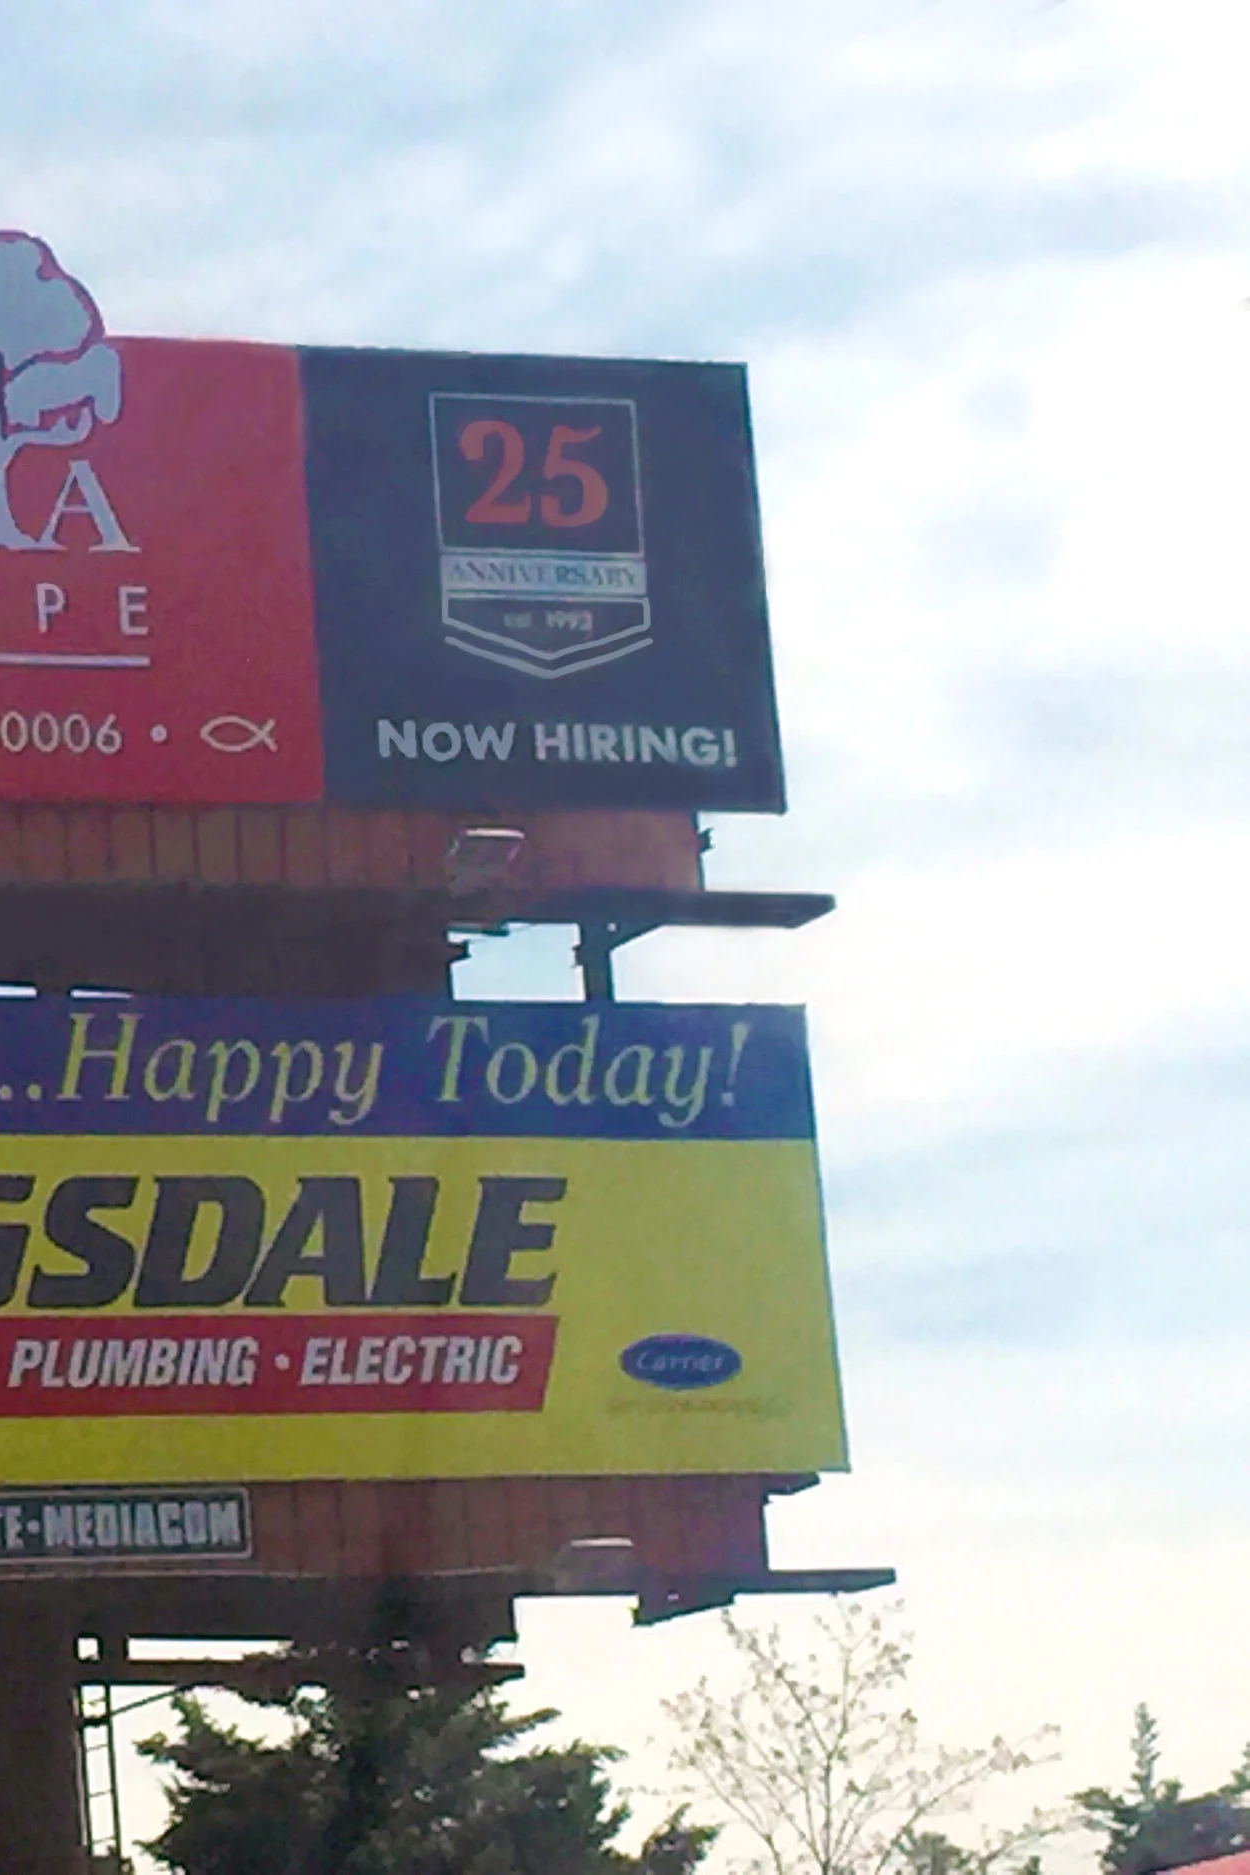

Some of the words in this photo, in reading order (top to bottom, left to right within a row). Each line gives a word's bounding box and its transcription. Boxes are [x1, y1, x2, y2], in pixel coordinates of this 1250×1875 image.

[457, 420, 610, 529] 25
[376, 720, 516, 762] NOW
[533, 723, 740, 768] HIRING!
[425, 1013, 748, 1128] Today!
[7, 1338, 258, 1389] PLUMBING
[300, 1334, 525, 1385] ELECTRIC
[635, 1351, 724, 1372] Carrier
